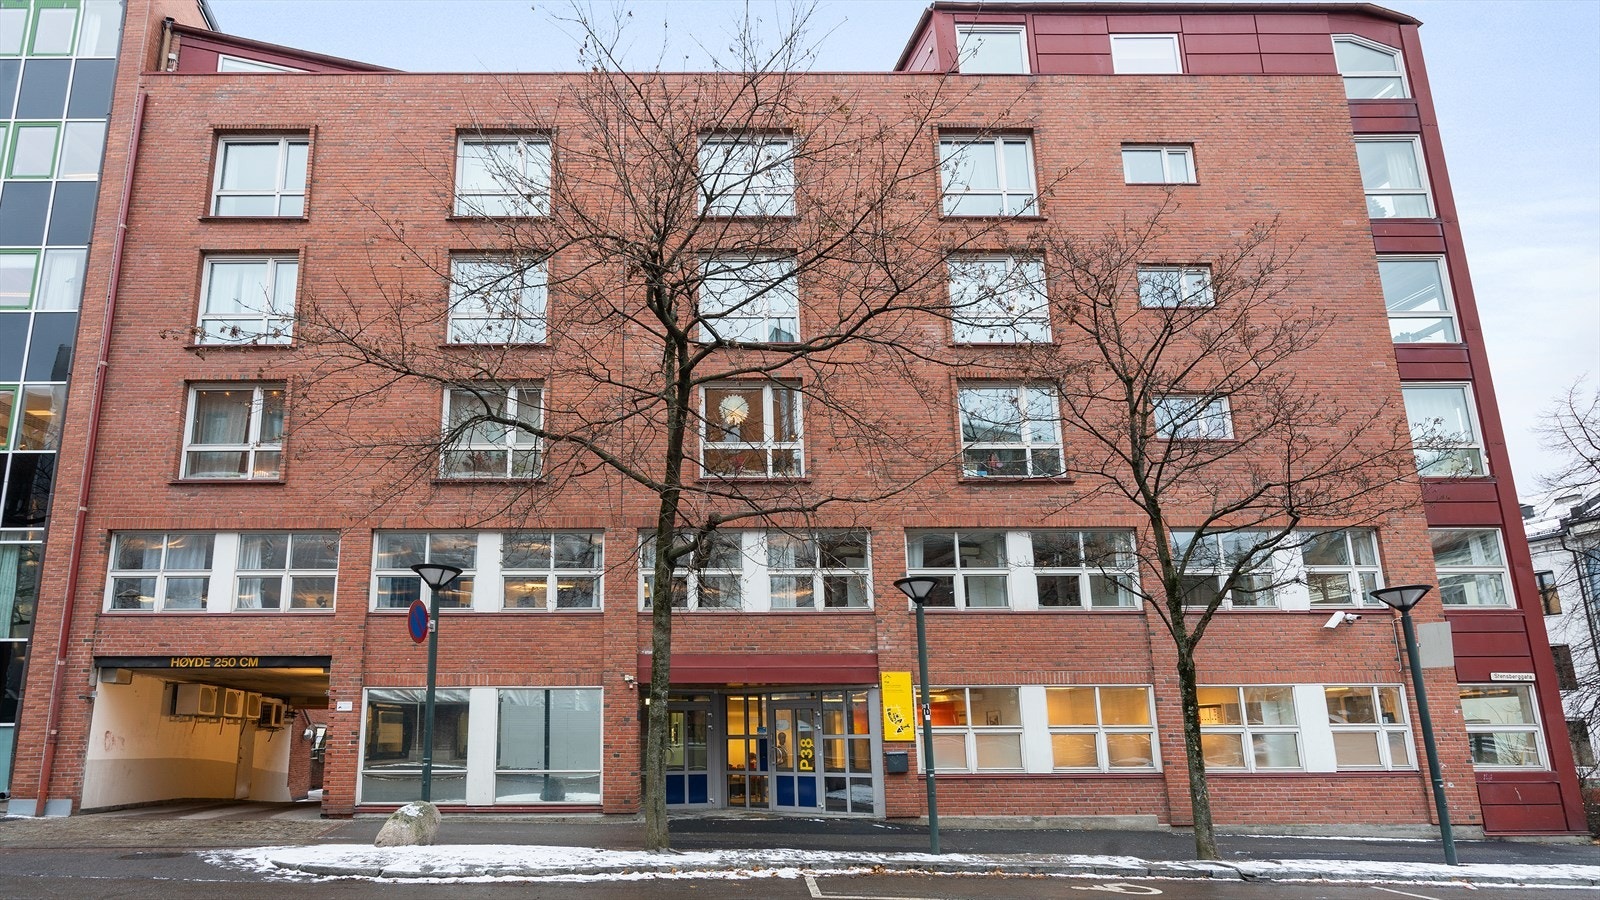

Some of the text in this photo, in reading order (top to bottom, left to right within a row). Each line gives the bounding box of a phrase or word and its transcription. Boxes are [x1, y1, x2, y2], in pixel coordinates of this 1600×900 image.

[170, 657, 259, 668] HØYDE 250 CM
[800, 738, 813, 771] P38
